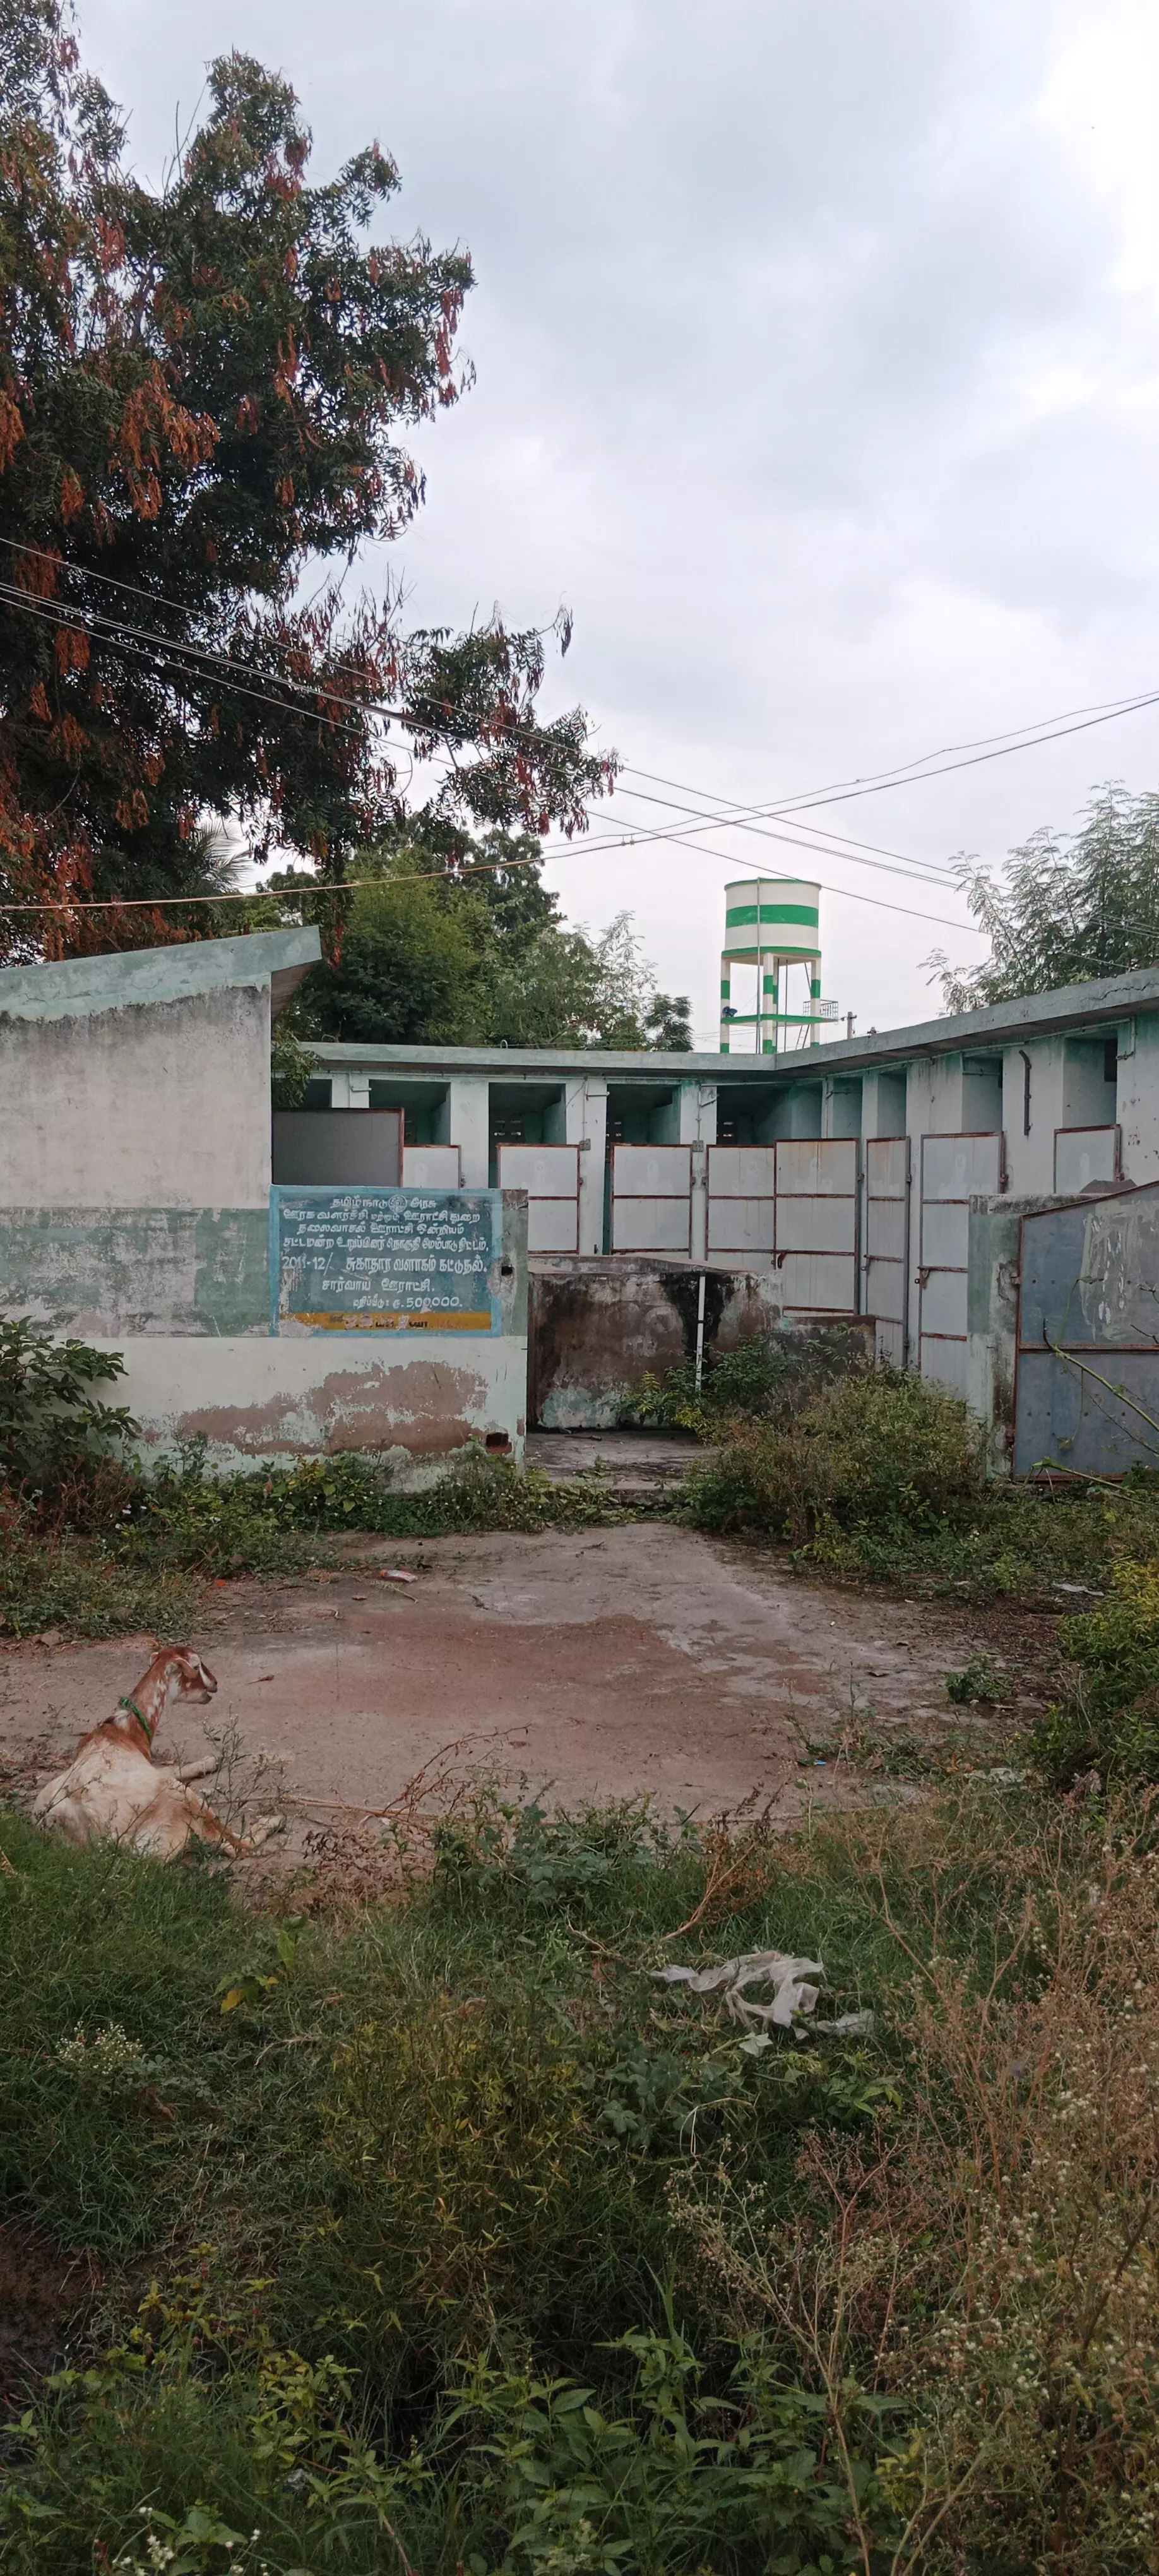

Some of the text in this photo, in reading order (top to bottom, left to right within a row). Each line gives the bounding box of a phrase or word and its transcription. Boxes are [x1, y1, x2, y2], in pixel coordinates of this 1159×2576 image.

[410, 1197, 437, 1210] அரசு
[317, 1208, 368, 1221] வளர்ச்சி
[371, 1211, 400, 1223] மற்றும்
[403, 1210, 448, 1223] ஊராட்சி
[450, 1213, 480, 1224] துறை
[297, 1220, 465, 1236] தலைவாசல் ஊராட்சி ஒன்றியம்
[336, 1234, 386, 1251] உறுப்பினர்
[387, 1236, 420, 1252] தொகுதி
[346, 1256, 391, 1275] சுகாதார
[393, 1254, 437, 1272] வளாகம்
